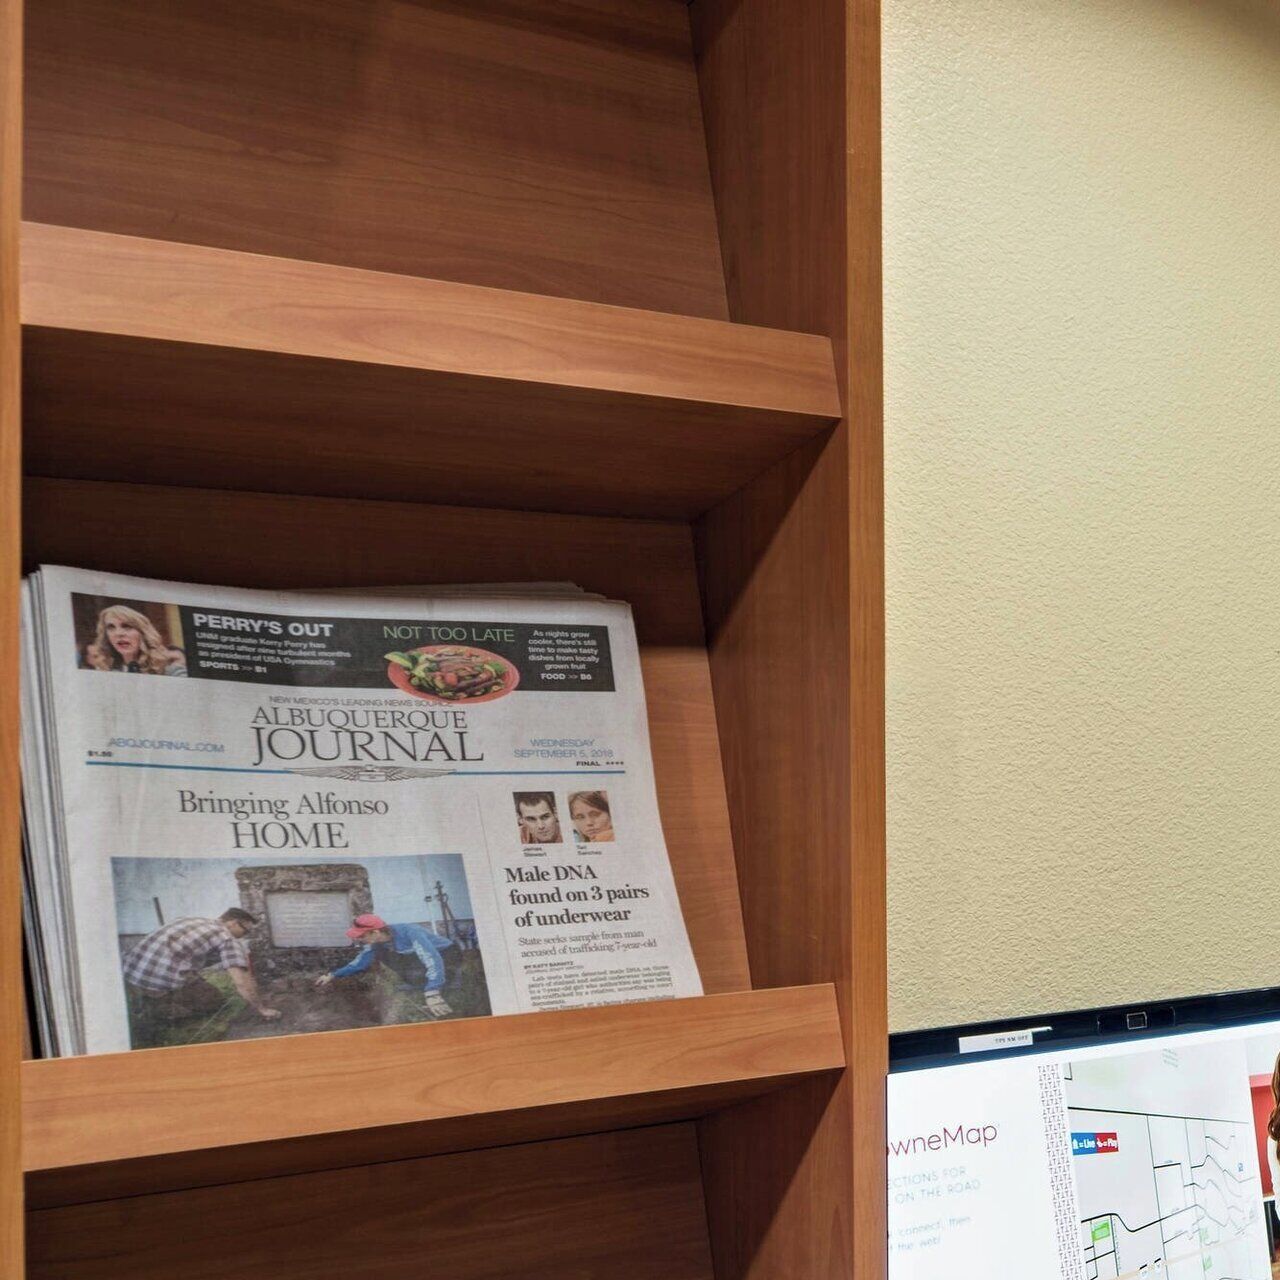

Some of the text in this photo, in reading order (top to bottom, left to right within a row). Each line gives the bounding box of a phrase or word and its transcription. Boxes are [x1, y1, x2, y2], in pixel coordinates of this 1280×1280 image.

[193, 613, 333, 637] PERRY'S OUT
[220, 635, 258, 644] graduate
[284, 640, 307, 649] Perry
[309, 641, 326, 649] has
[383, 626, 515, 642] NOT TOO LATE
[210, 652, 251, 661] president
[284, 657, 336, 666] Gymnastics
[277, 648, 316, 657] turbulent
[200, 660, 240, 671] SPORTS
[269, 696, 291, 704] NEW
[293, 697, 339, 706] MEXICO'S
[341, 699, 381, 707] LEADING
[251, 706, 468, 731] ALBUQUERQUE
[107, 738, 225, 753] ABQJOURNAL.COM
[251, 726, 484, 766] JOURNAL
[530, 739, 595, 748] WEDNESDAY
[513, 750, 577, 759] SEPTEMBER
[591, 750, 614, 759] 2018
[178, 790, 389, 820] Bringing Alfonso
[231, 822, 350, 849] HOME
[504, 864, 598, 883] Male DNA
[509, 884, 650, 906] found on 3 pairs
[514, 908, 632, 928] of underwear
[518, 931, 645, 946] State seeks sample from man
[521, 946, 557, 958] accused
[558, 945, 568, 955] of
[568, 942, 615, 955] trafficking
